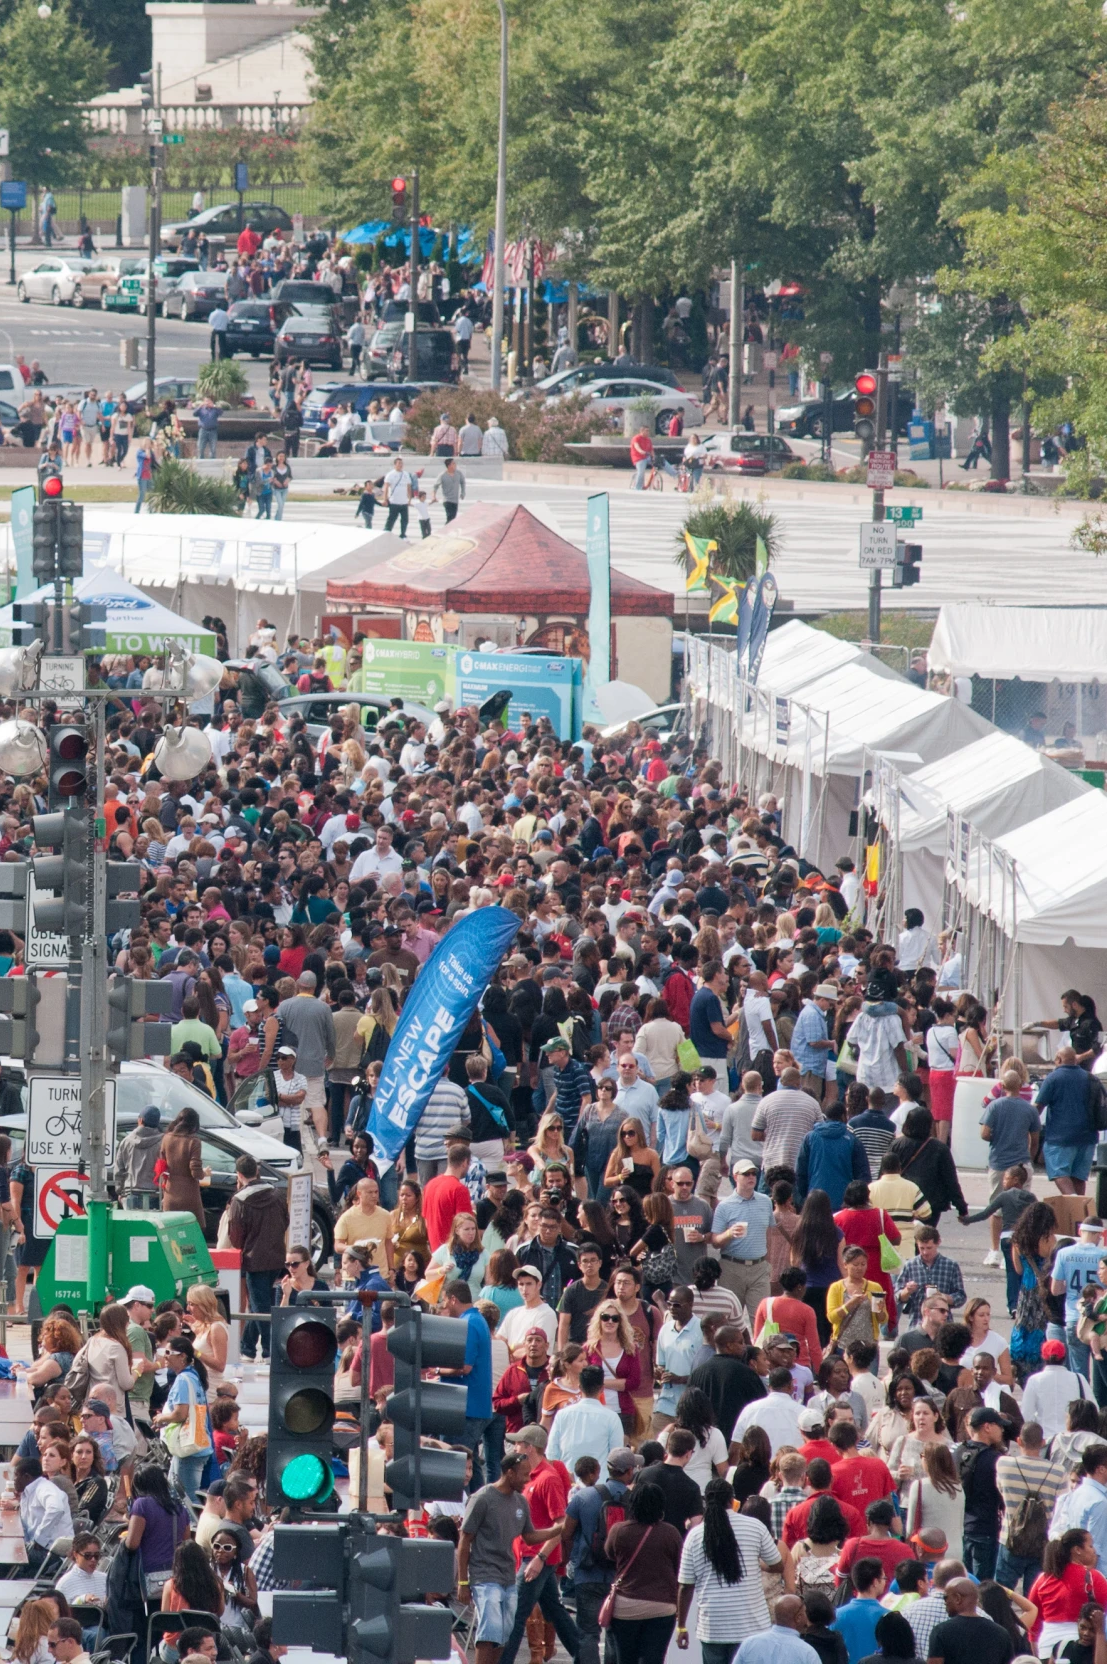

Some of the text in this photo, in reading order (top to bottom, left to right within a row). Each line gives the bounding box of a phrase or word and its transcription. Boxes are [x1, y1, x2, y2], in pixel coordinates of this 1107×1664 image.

[890, 507, 903, 518] 13
[111, 634, 143, 652] TO
[45, 662, 75, 671] TURNING
[375, 1014, 424, 1114] ALL-NEW
[388, 1005, 456, 1130] ESCAPE
[31, 1141, 54, 1155] USE
[55, 1291, 81, 1299] 157745
